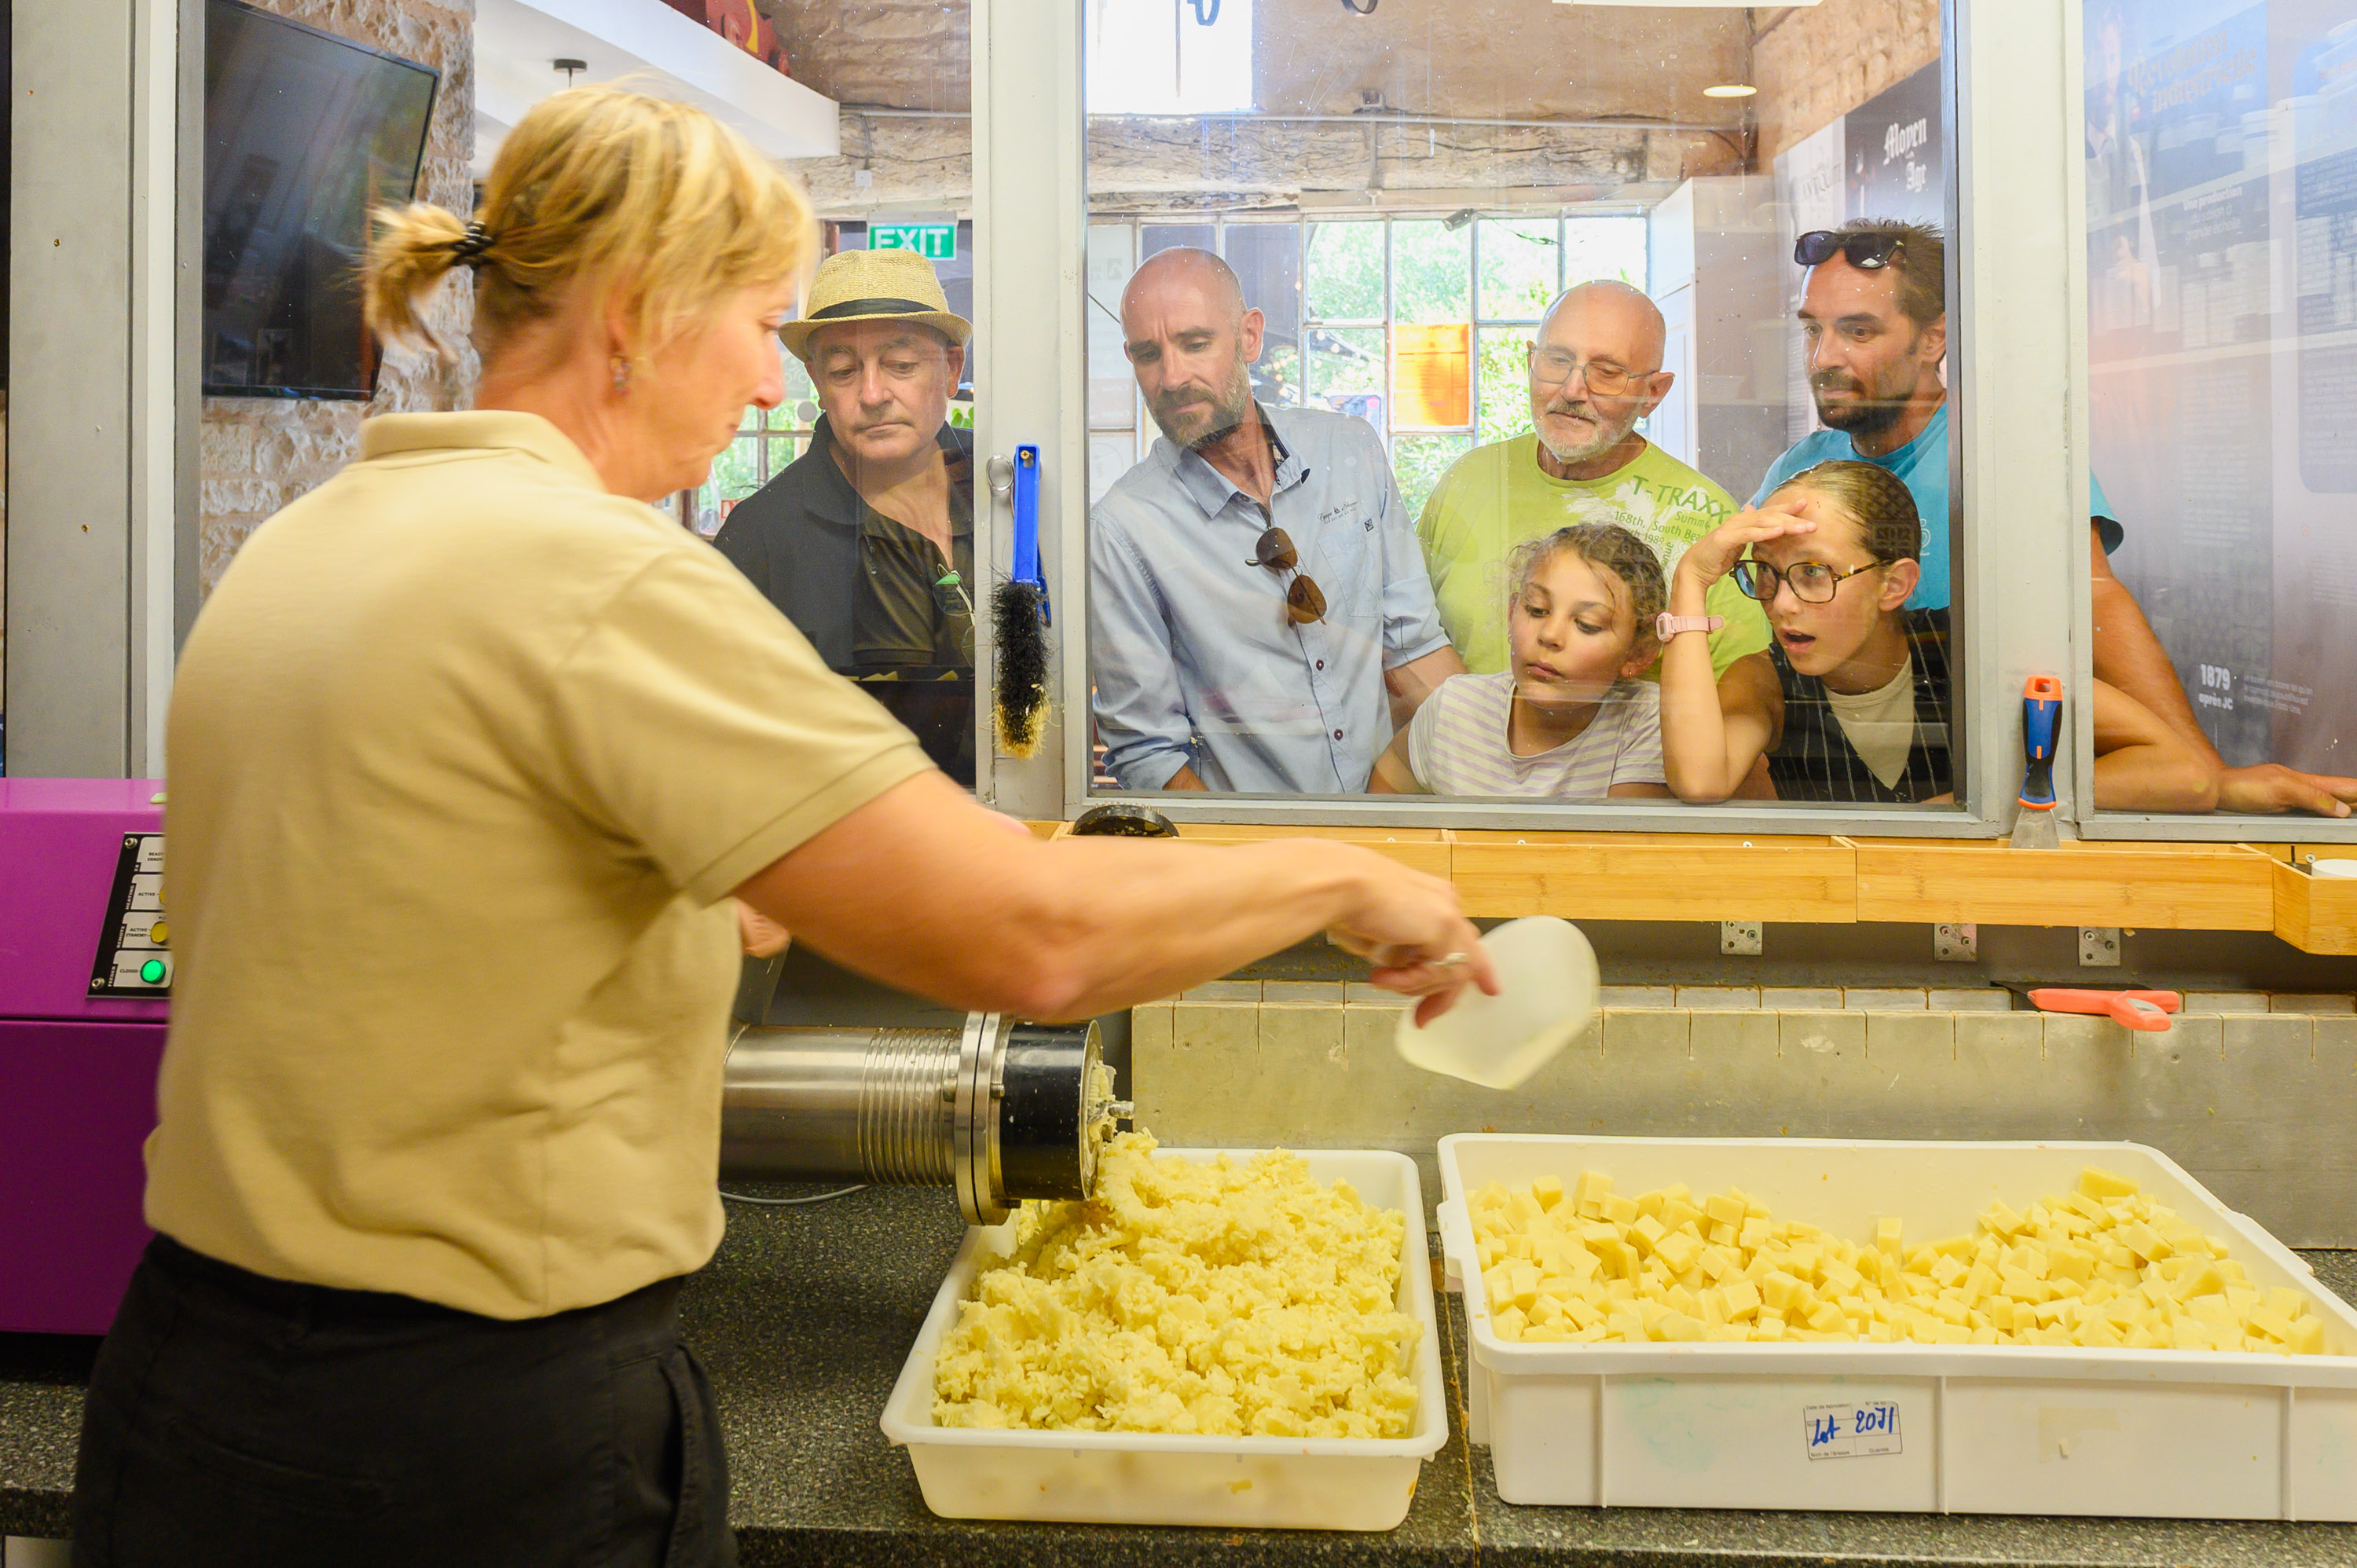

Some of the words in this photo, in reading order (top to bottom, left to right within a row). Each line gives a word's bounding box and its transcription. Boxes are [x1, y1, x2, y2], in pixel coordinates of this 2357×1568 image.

[1883, 118, 1926, 166] Moyen
[874, 228, 949, 255] EXIT
[1633, 474, 1732, 526] T-TRAXX
[1615, 511, 1646, 529] 168th,
[1652, 520, 1681, 537] South
[1644, 532, 1665, 546] 1989
[2201, 663, 2231, 691] 1879
[2198, 692, 2222, 709] après
[2223, 697, 2233, 711] JC
